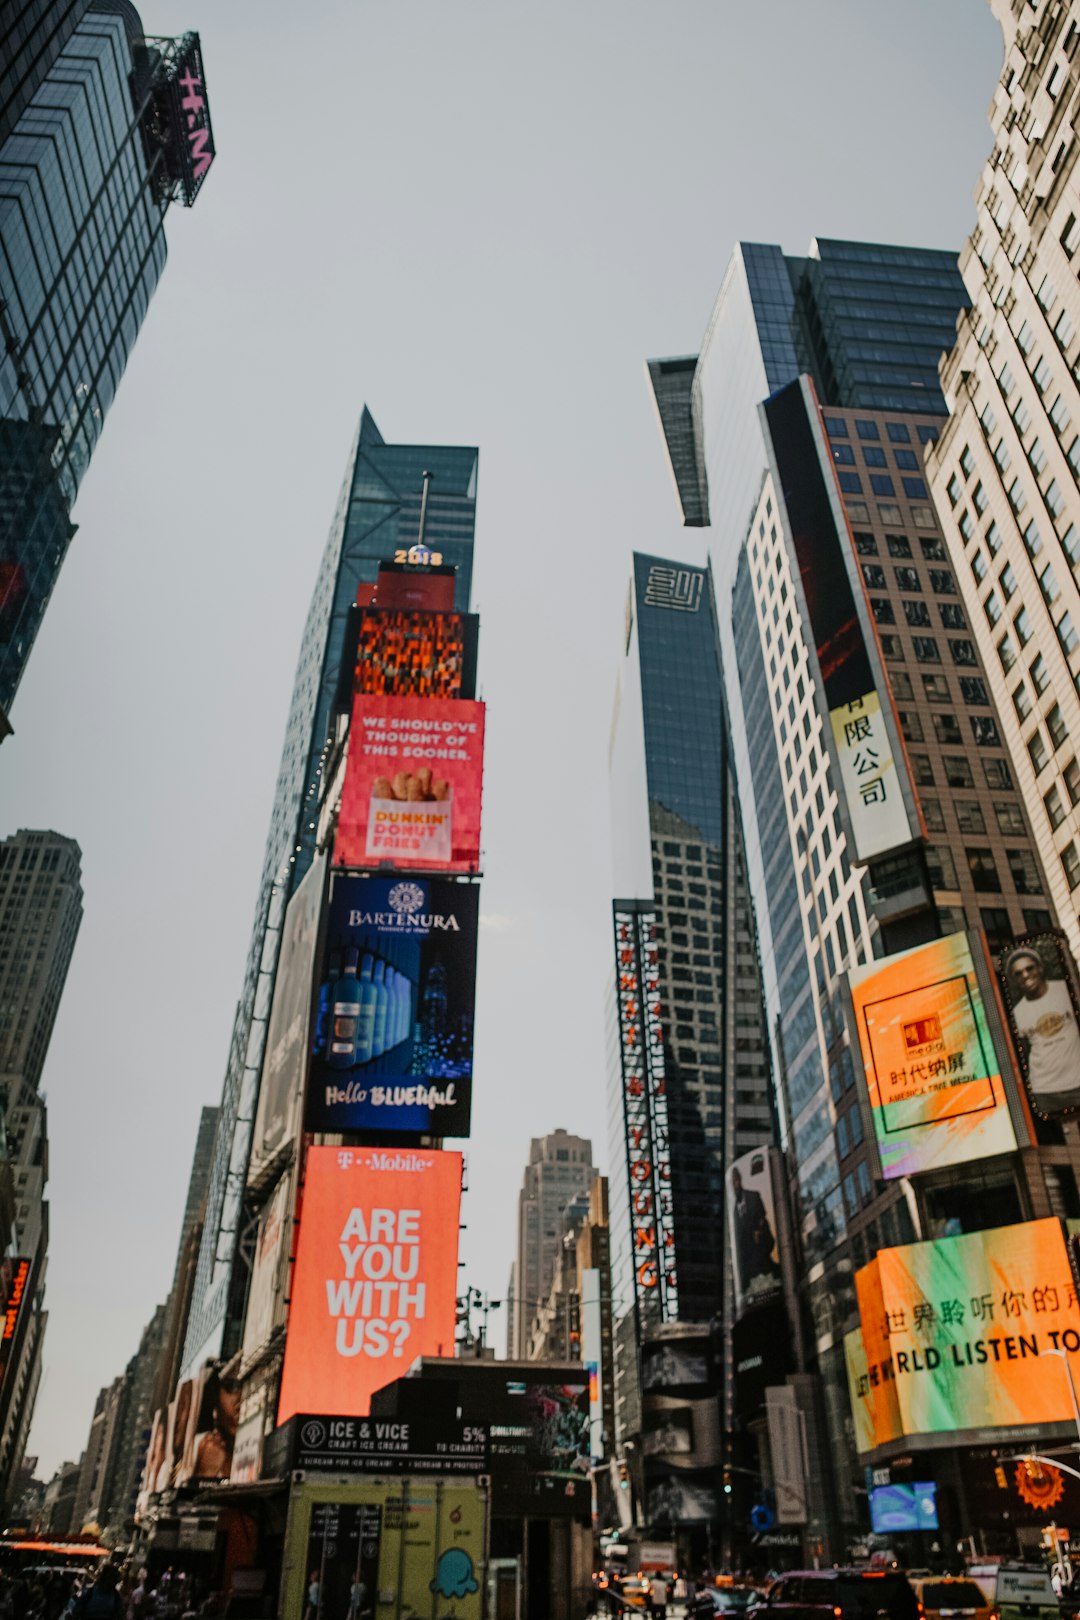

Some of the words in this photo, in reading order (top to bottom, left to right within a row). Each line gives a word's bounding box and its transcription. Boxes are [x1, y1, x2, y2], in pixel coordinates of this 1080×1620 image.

[394, 550, 443, 566] 2018
[363, 716, 386, 729] WE
[391, 718, 477, 733] SHOULD'VE
[366, 731, 441, 745] THOUGHT
[446, 735, 467, 746] OF
[363, 744, 398, 756] THIS
[402, 746, 472, 760] SOONER.
[376, 811, 448, 824] DUNKIN'
[374, 824, 436, 837] DONUT
[373, 836, 421, 849] FRIES
[325, 1080, 368, 1106] Hello
[630, 1126, 657, 1287] YOUNG
[340, 1207, 422, 1244] ARE
[338, 1243, 420, 1281] YOU
[325, 1279, 427, 1319] WITH
[335, 1318, 411, 1358] US?
[951, 1334, 1039, 1368] LISTEN
[1047, 1328, 1080, 1352] TO
[329, 1421, 354, 1438] ICE
[359, 1422, 371, 1439] &
[375, 1423, 410, 1440] VICE
[463, 1426, 486, 1442] 5%
[328, 1439, 357, 1449] CRAFT
[360, 1441, 375, 1450] ICE
[377, 1441, 409, 1451] CREAM
[436, 1443, 447, 1453] TO
[449, 1443, 485, 1453] CHARITY
